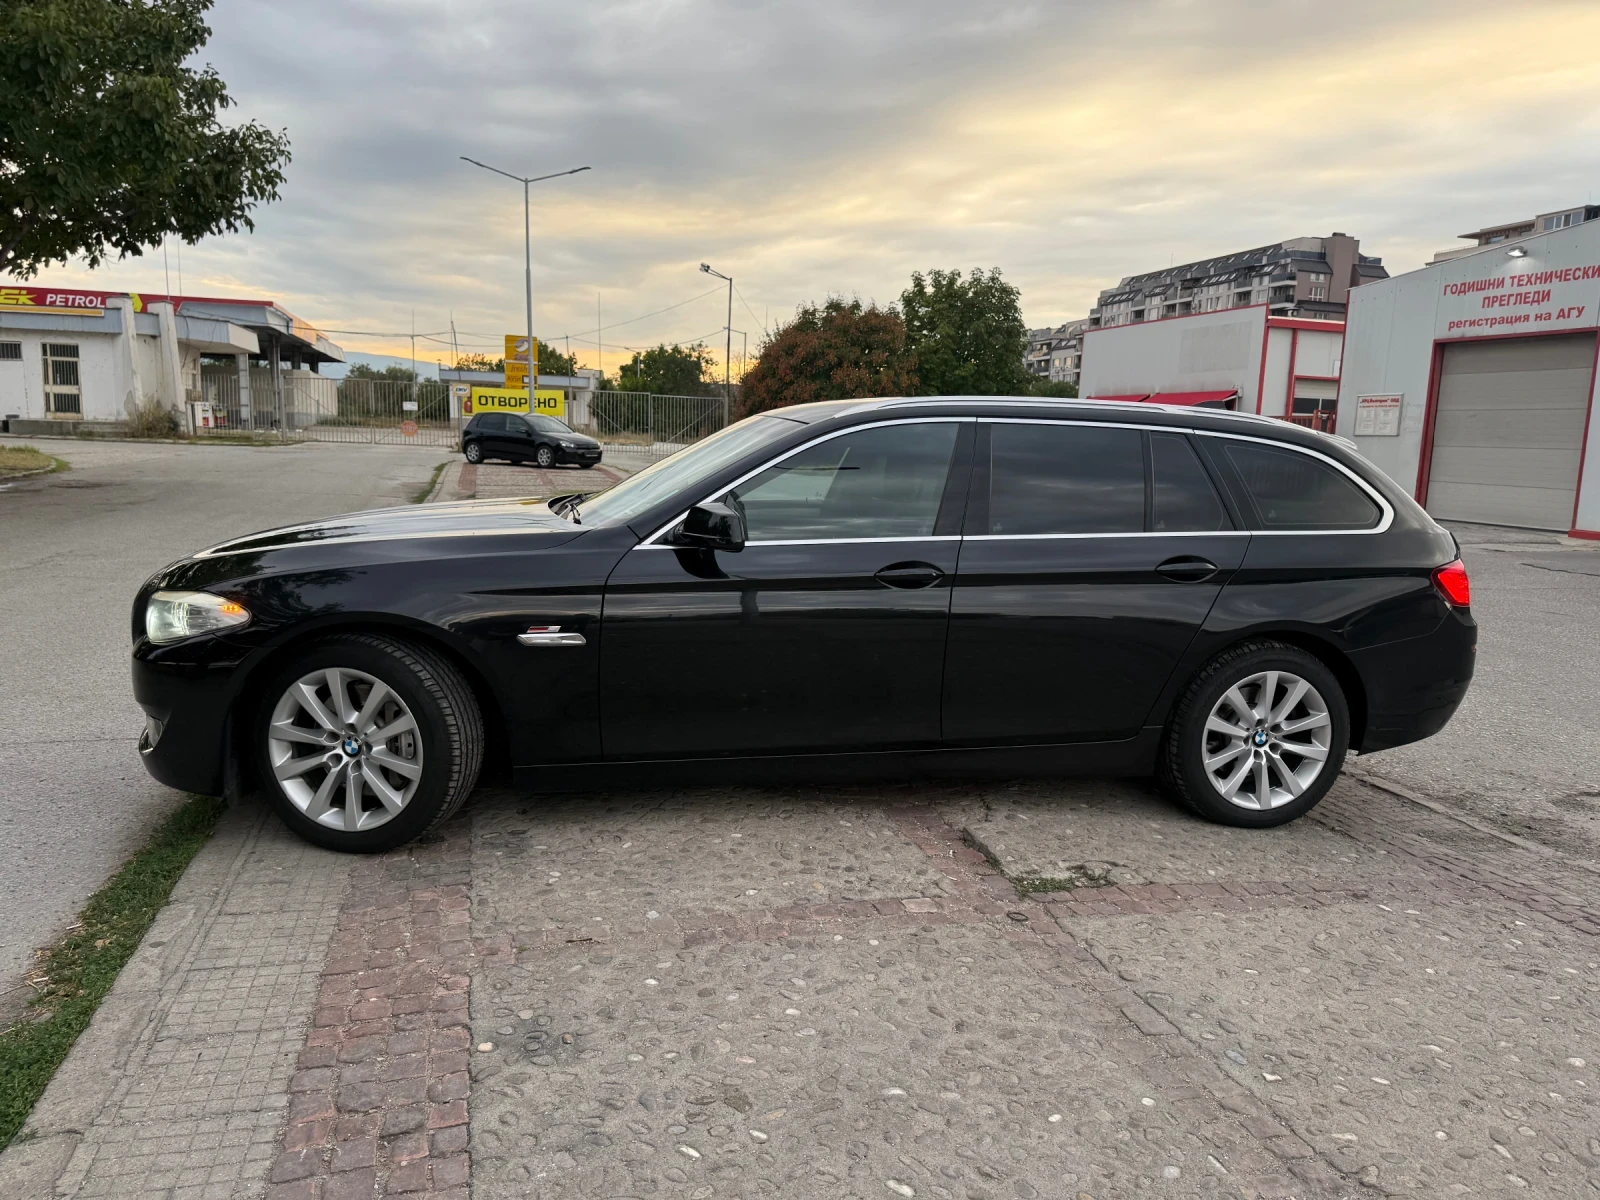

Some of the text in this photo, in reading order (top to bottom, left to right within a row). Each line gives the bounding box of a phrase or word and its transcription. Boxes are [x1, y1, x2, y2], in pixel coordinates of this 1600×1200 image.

[1443, 264, 1600, 296] ГОДИШНИ ТЕХНИЧЕСКИ
[45, 293, 105, 308] PETROL
[1482, 289, 1551, 309] ПРЕГЛЕДИ
[1448, 306, 1585, 331] регистрация на АГУ
